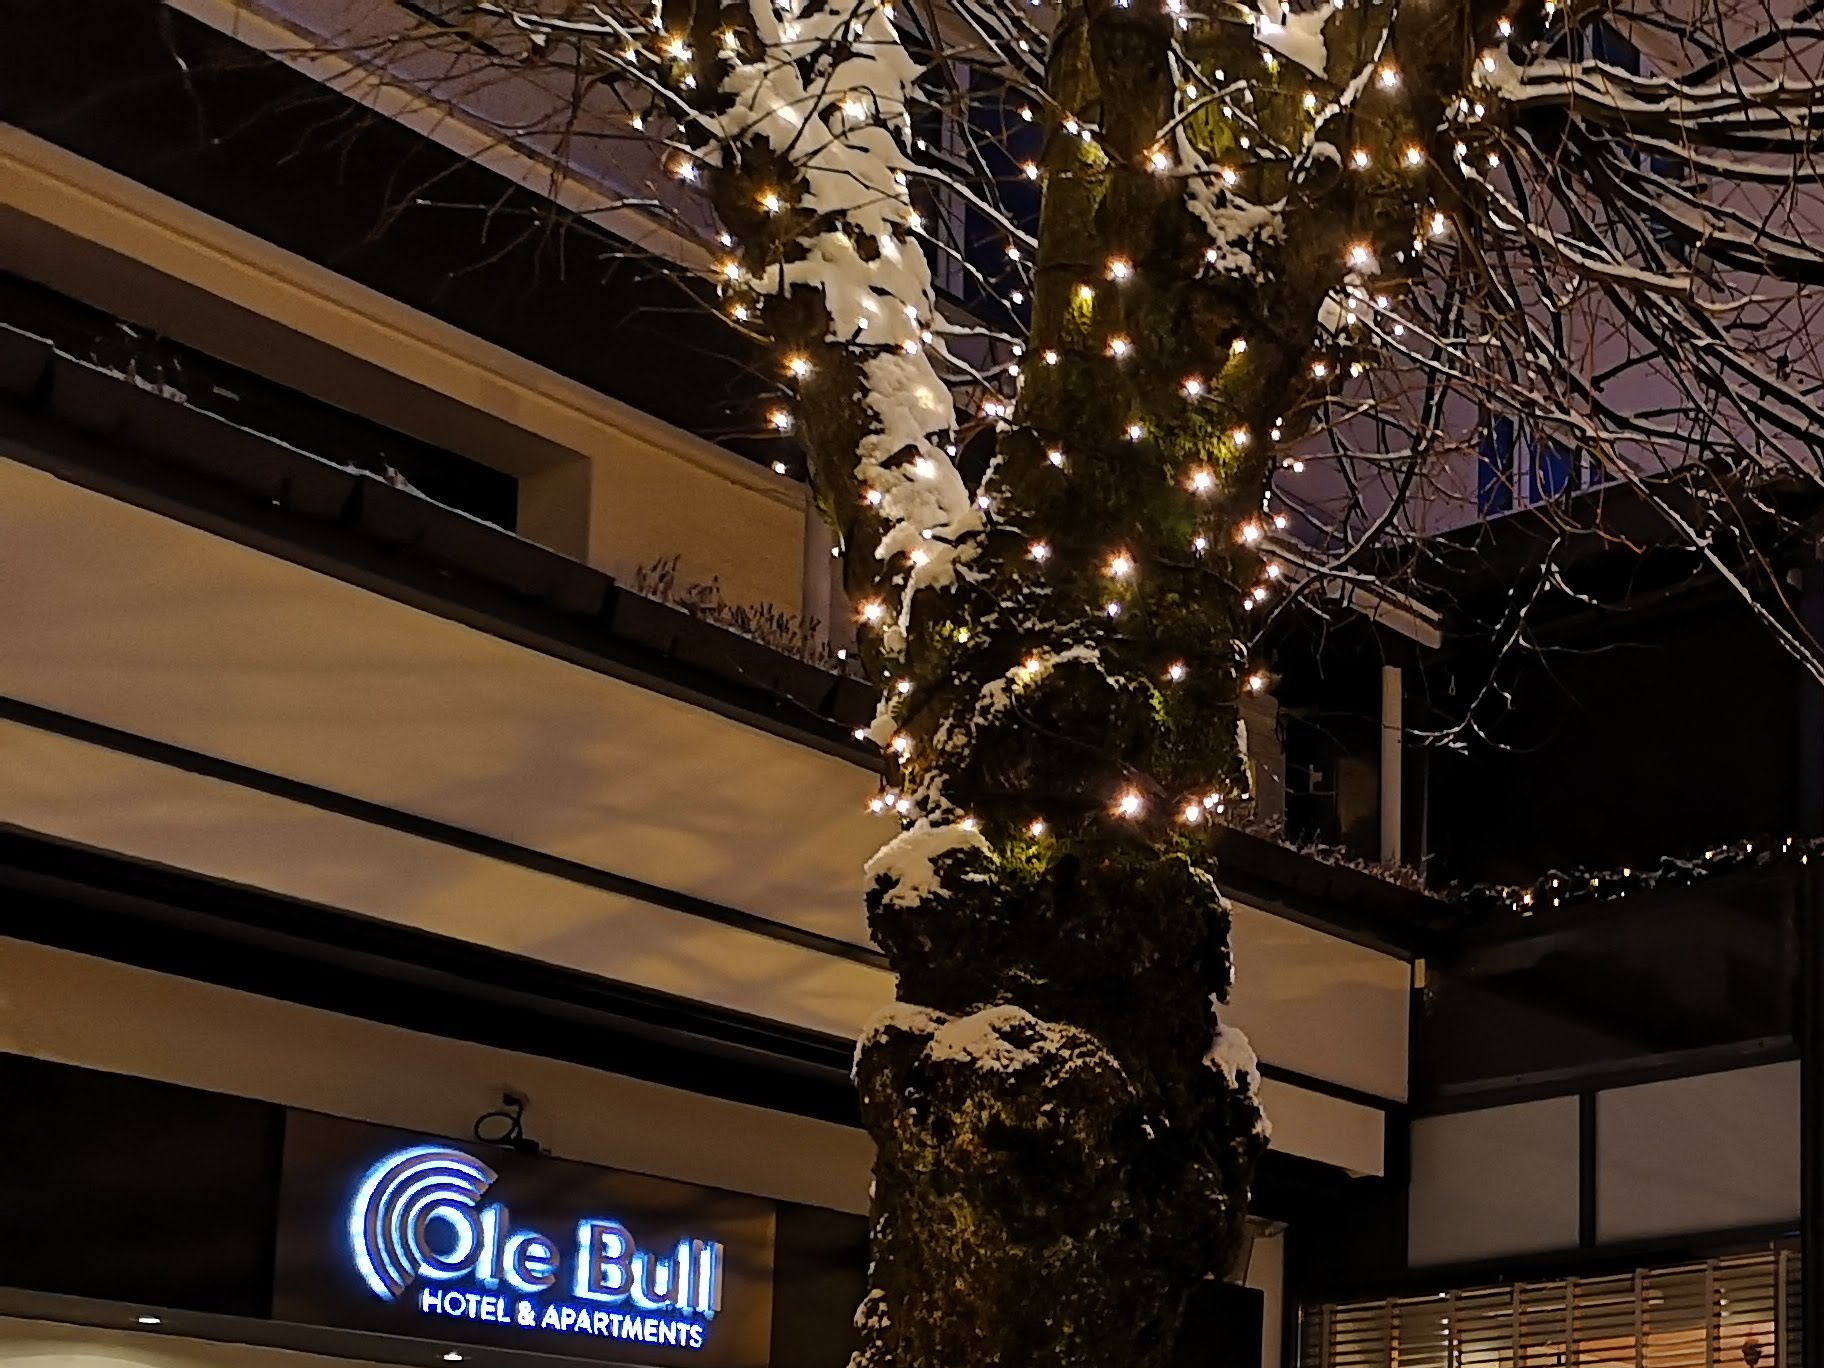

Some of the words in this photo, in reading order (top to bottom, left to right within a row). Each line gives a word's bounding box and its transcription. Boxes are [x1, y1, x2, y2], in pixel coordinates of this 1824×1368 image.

[408, 1199, 560, 1294] Ole
[573, 1217, 725, 1319] Bull
[421, 1287, 511, 1325] HOTEL
[516, 1301, 537, 1329] &
[541, 1303, 704, 1349] APARTMENTS
